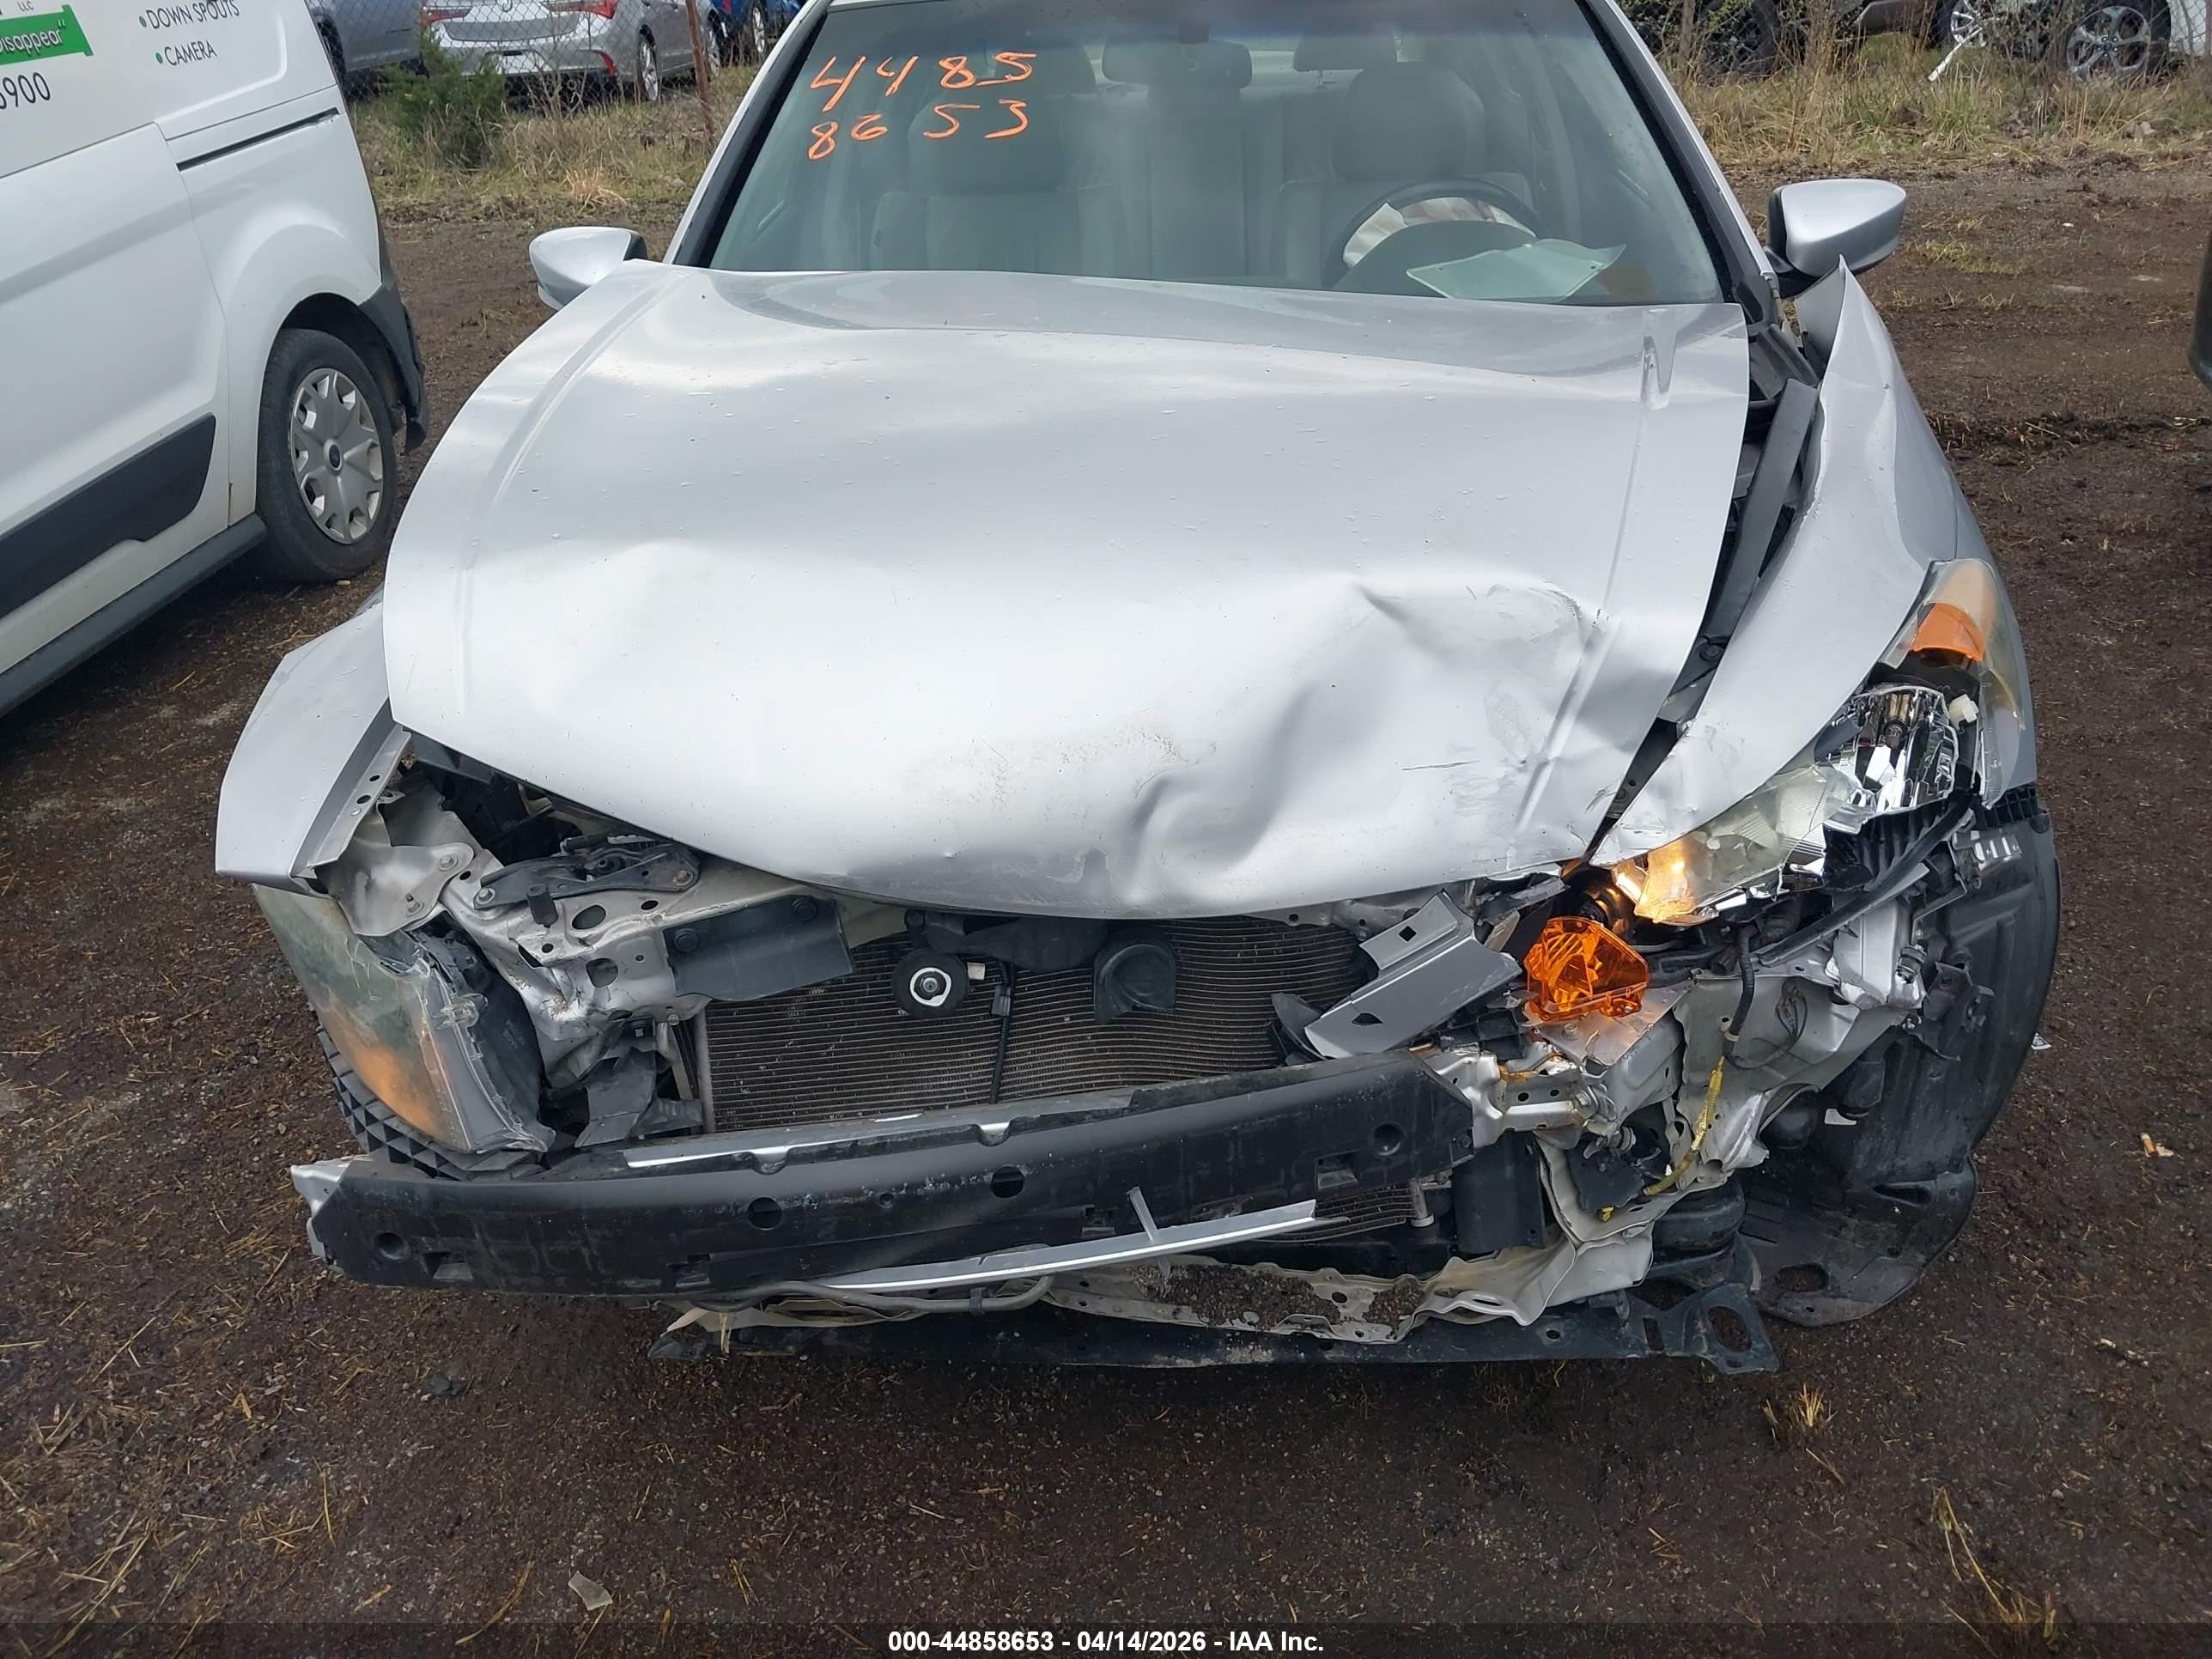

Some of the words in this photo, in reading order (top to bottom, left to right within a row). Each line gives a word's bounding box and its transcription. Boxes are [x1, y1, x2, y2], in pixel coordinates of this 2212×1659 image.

[17, 0, 34, 12] LLC
[145, 4, 194, 29] DOWN
[191, 0, 240, 22] SPOUTS
[164, 40, 218, 66] CAMERA
